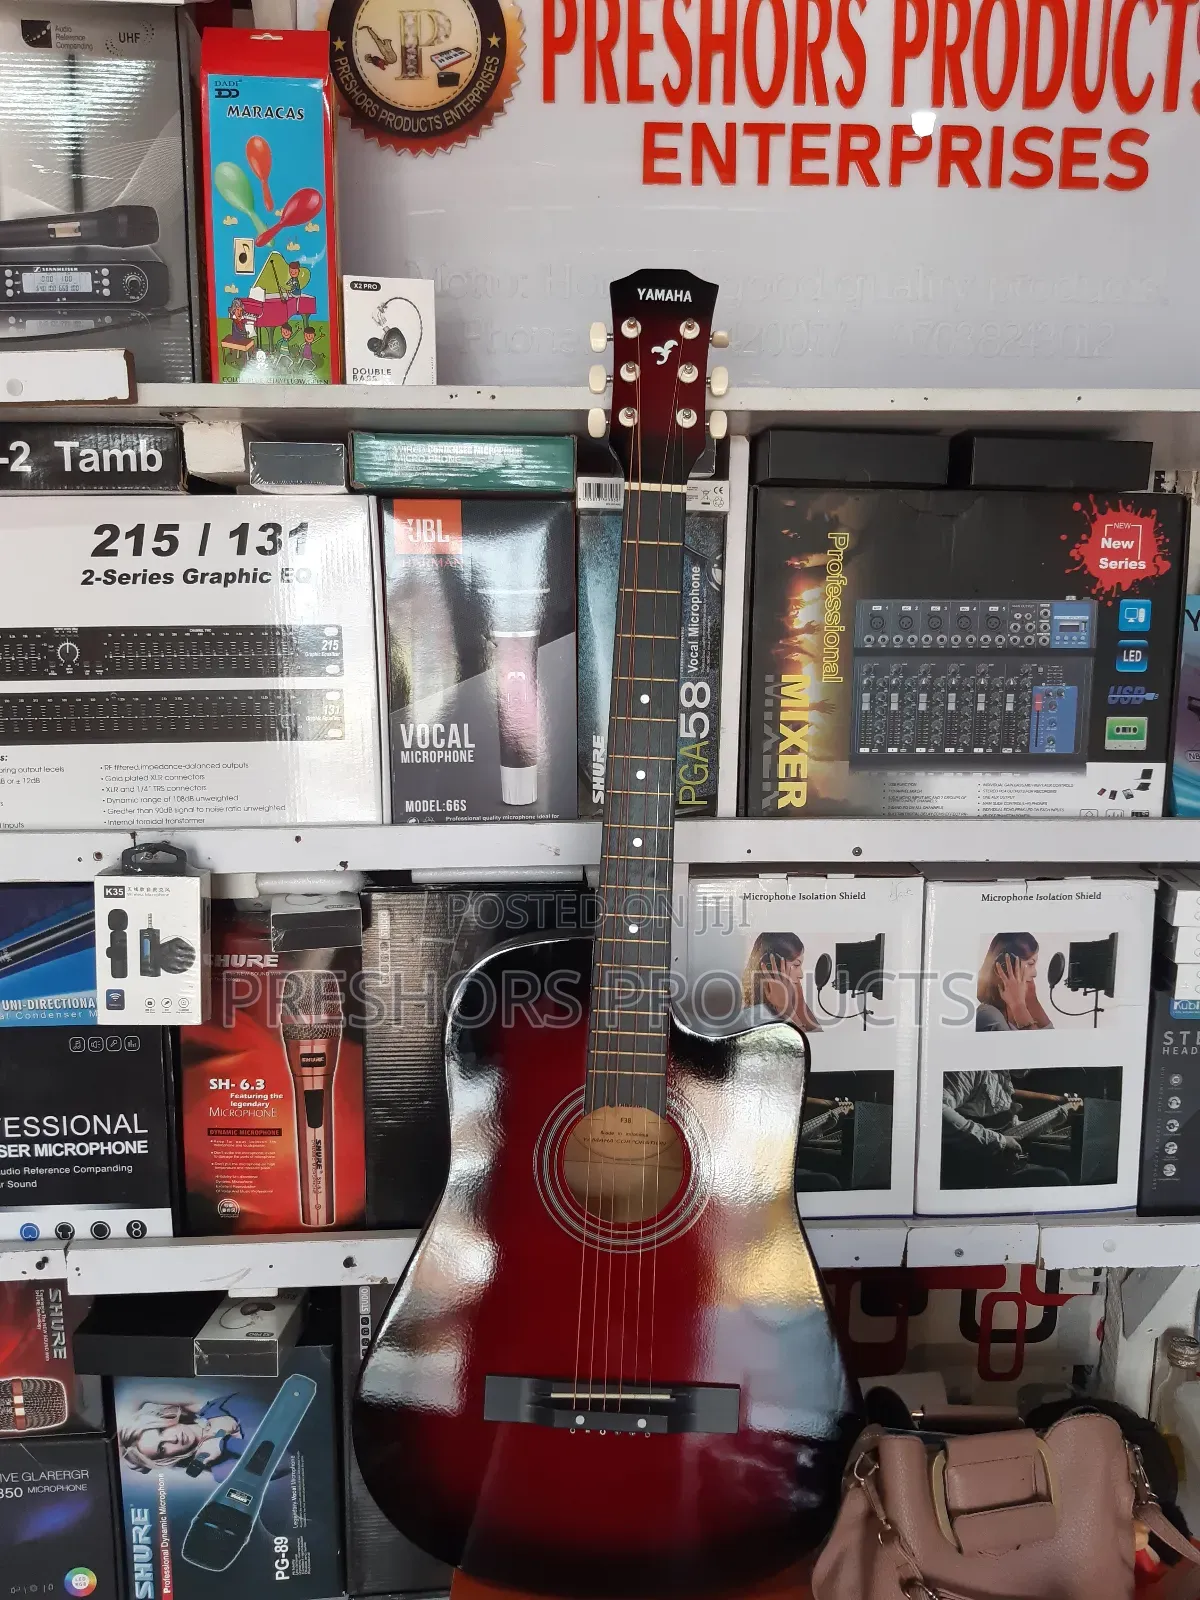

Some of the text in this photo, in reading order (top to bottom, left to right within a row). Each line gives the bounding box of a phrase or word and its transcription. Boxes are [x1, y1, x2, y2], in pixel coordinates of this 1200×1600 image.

[55, 25, 72, 33] Audio
[118, 32, 140, 43] UHF
[55, 42, 93, 51] Companding
[542, 0, 868, 108] PRESHORS
[336, 55, 500, 134] PRESHORS PRODUCTS ENTERPRISES
[226, 105, 305, 121] MARACAS
[642, 121, 1151, 191] ENTERPRISES
[353, 282, 378, 290] X2 PRO
[637, 288, 693, 303] YAMAHA
[352, 367, 392, 376] DOUBLE
[54, 440, 163, 473] Tamb
[408, 518, 450, 543] JBL
[90, 523, 181, 558] 215
[228, 521, 310, 558] 131
[1101, 537, 1134, 549] New
[1098, 557, 1147, 570] Series
[80, 566, 313, 589] 2-Series Graphic EQ
[822, 531, 850, 685] Professional
[687, 566, 702, 673] Vocal Microphone
[322, 639, 339, 651] 215
[1123, 650, 1142, 662] LED
[400, 722, 476, 749] VOCAL
[777, 674, 811, 810] MIXER
[678, 680, 711, 806] PGA58
[400, 749, 475, 764] MICROPHONE
[221, 762, 249, 770] outputs
[592, 734, 607, 805] SHURE
[23, 776, 41, 784] 12dB
[124, 774, 149, 783] plated
[164, 773, 205, 781] connectors
[166, 784, 207, 792] connectors
[205, 805, 225, 813] noise
[243, 804, 286, 812] unweighted
[405, 800, 467, 813] MODEL:66S
[482, 815, 501, 823] quality
[502, 814, 536, 822] microphone
[105, 888, 124, 897] K35
[742, 890, 867, 903] Microphone Isolation Shield
[981, 890, 1102, 904] Microphone Isolation Shield
[2, 997, 97, 1011] UNI-DIRECTIONA
[16, 1010, 83, 1020] Condenser
[239, 1078, 266, 1091] 6.3
[230, 1092, 284, 1101] Featuring the
[230, 1101, 270, 1109] legendary
[0, 1113, 149, 1138] ESSIONAL
[34, 1140, 149, 1157] MICROPHONE
[315, 1138, 323, 1170] SHURE
[23, 1166, 71, 1175] Reference
[73, 1164, 133, 1174] Companding
[7, 1180, 38, 1189] Sound
[361, 1288, 370, 1312] STUDIO
[48, 1287, 68, 1360] SHURE
[21, 1469, 90, 1482] GLARERGR
[27, 1484, 88, 1494] MICROPHONE
[159, 1473, 172, 1594] Professional Dynamic Microphone
[131, 1507, 156, 1600] SHURE
[273, 1536, 291, 1581] PG-89
